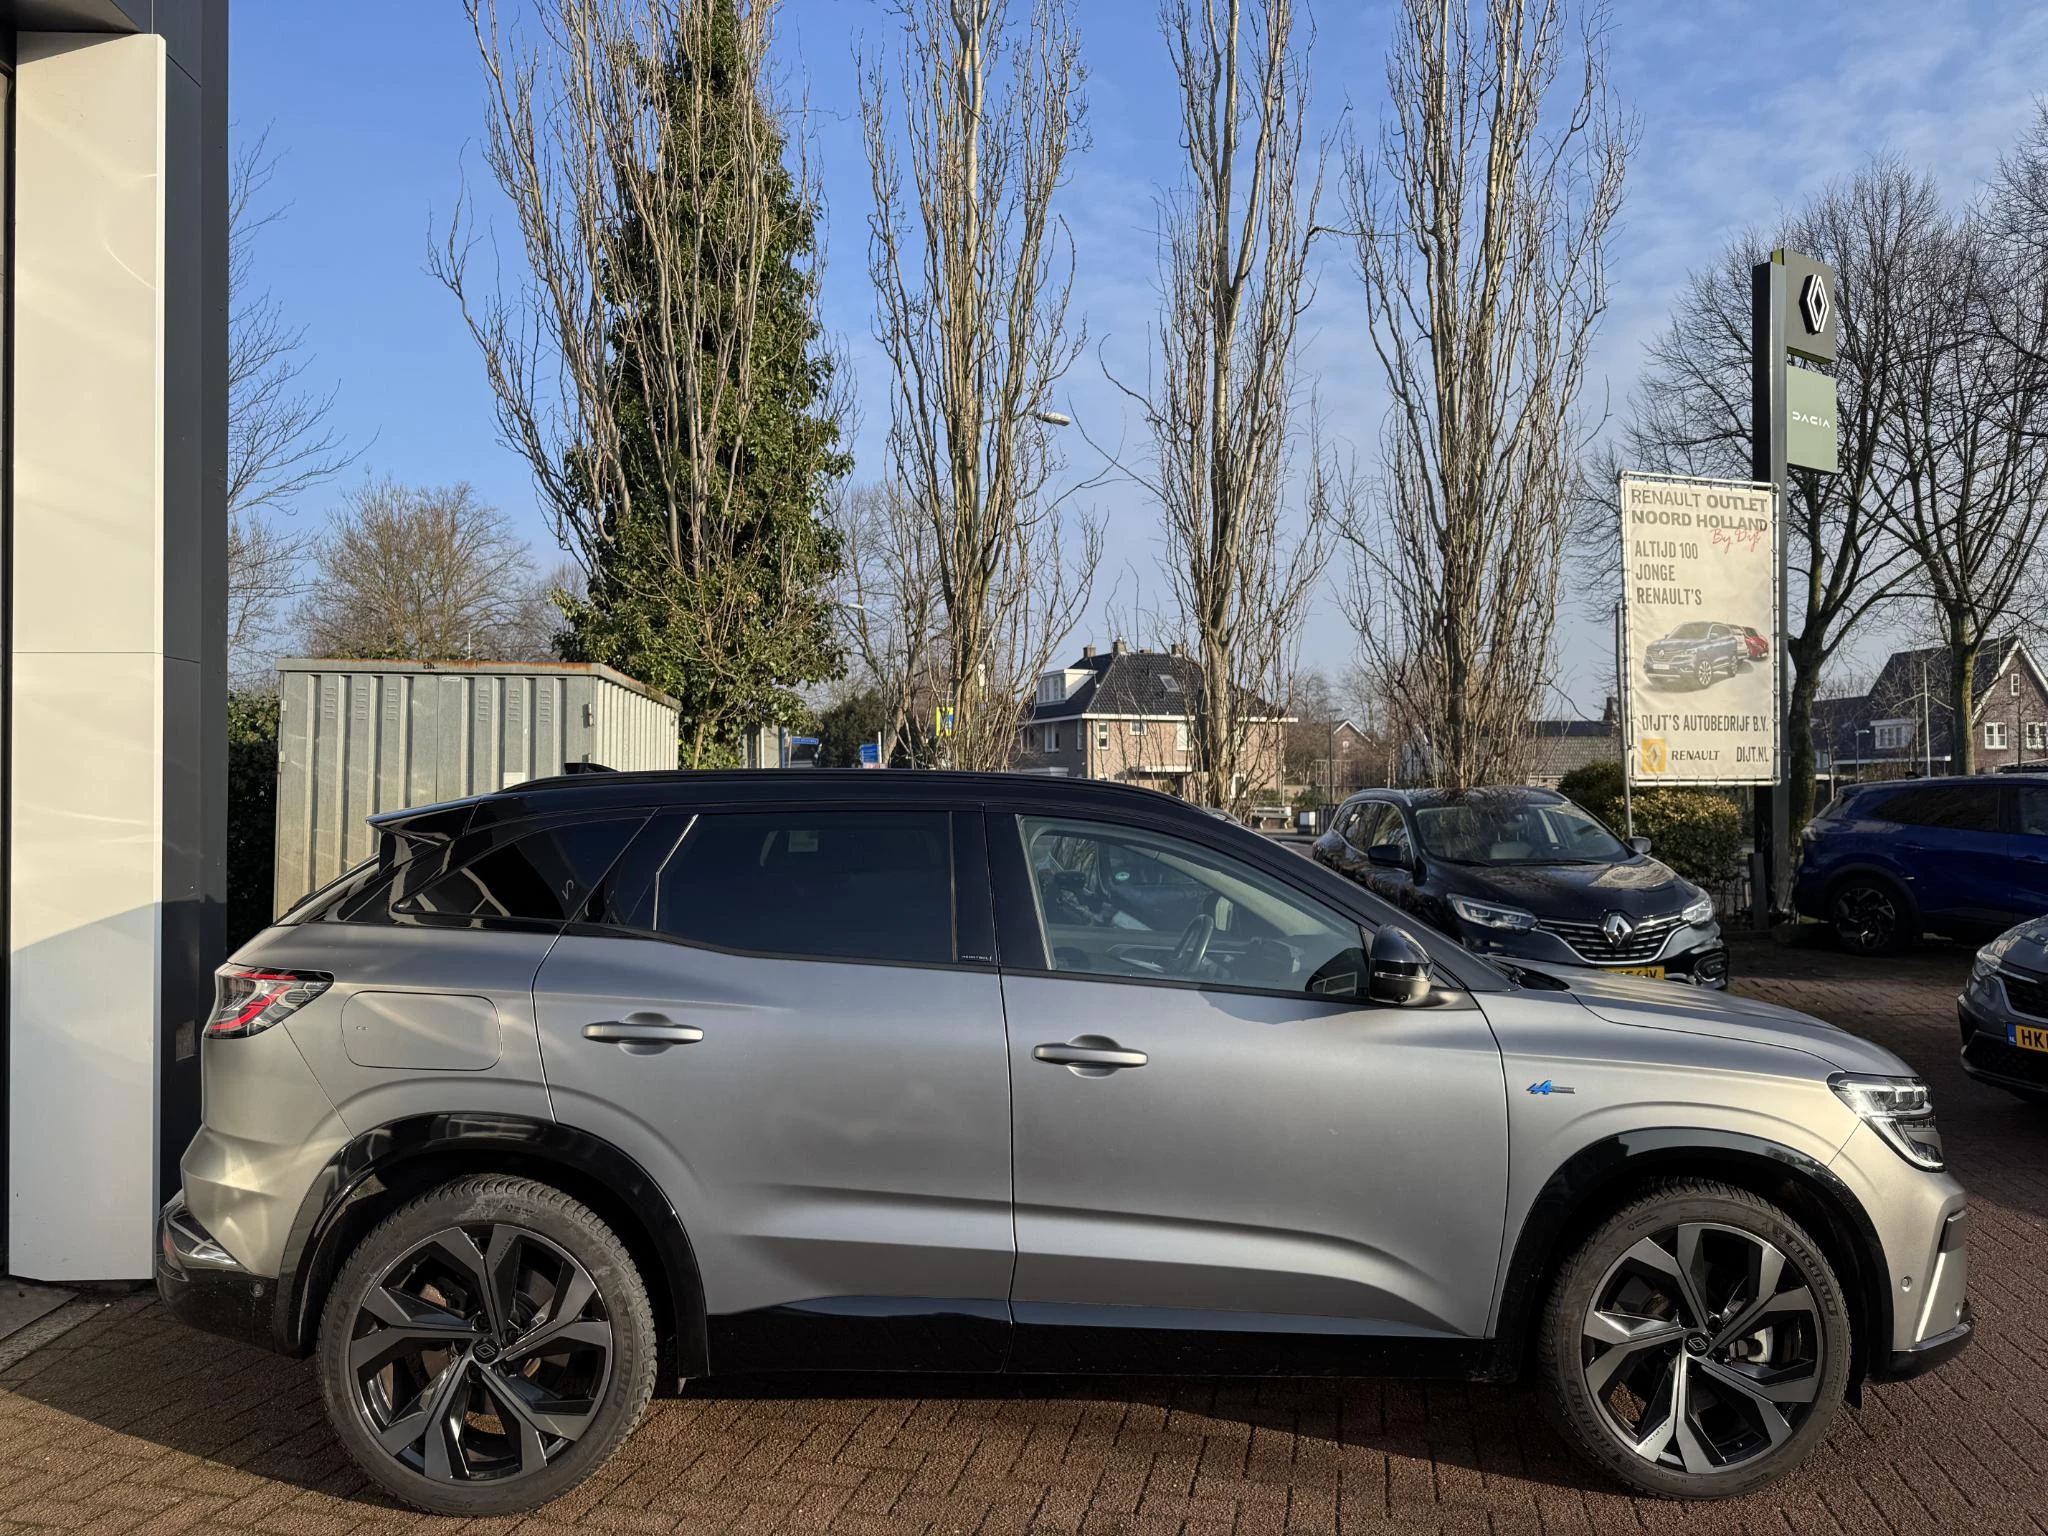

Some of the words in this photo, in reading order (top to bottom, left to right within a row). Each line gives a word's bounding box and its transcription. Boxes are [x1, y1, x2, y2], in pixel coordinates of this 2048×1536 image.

[1792, 410, 1831, 429] DACIA
[1631, 489, 1701, 508] RENAULT
[1706, 494, 1768, 513] OUTLET
[1631, 510, 1692, 526] NOORD
[1696, 514, 1768, 531] HOLLAND
[1635, 540, 1677, 558] ALTIJD
[1680, 542, 1698, 559] 100
[1711, 528, 1733, 554] By
[1635, 563, 1676, 582] JONGE
[1636, 587, 1702, 605] RENAULT'S
[1642, 714, 1680, 731] DIJT'S
[1683, 714, 1750, 732] AUTOBEDRIJF
[1752, 716, 1769, 732] B.V.
[1671, 750, 1720, 761] RENAULT
[1736, 746, 1769, 763] DIJT.NL
[2021, 1029, 2048, 1051] HK
[1788, 1240, 1838, 1316] MICHELIN
